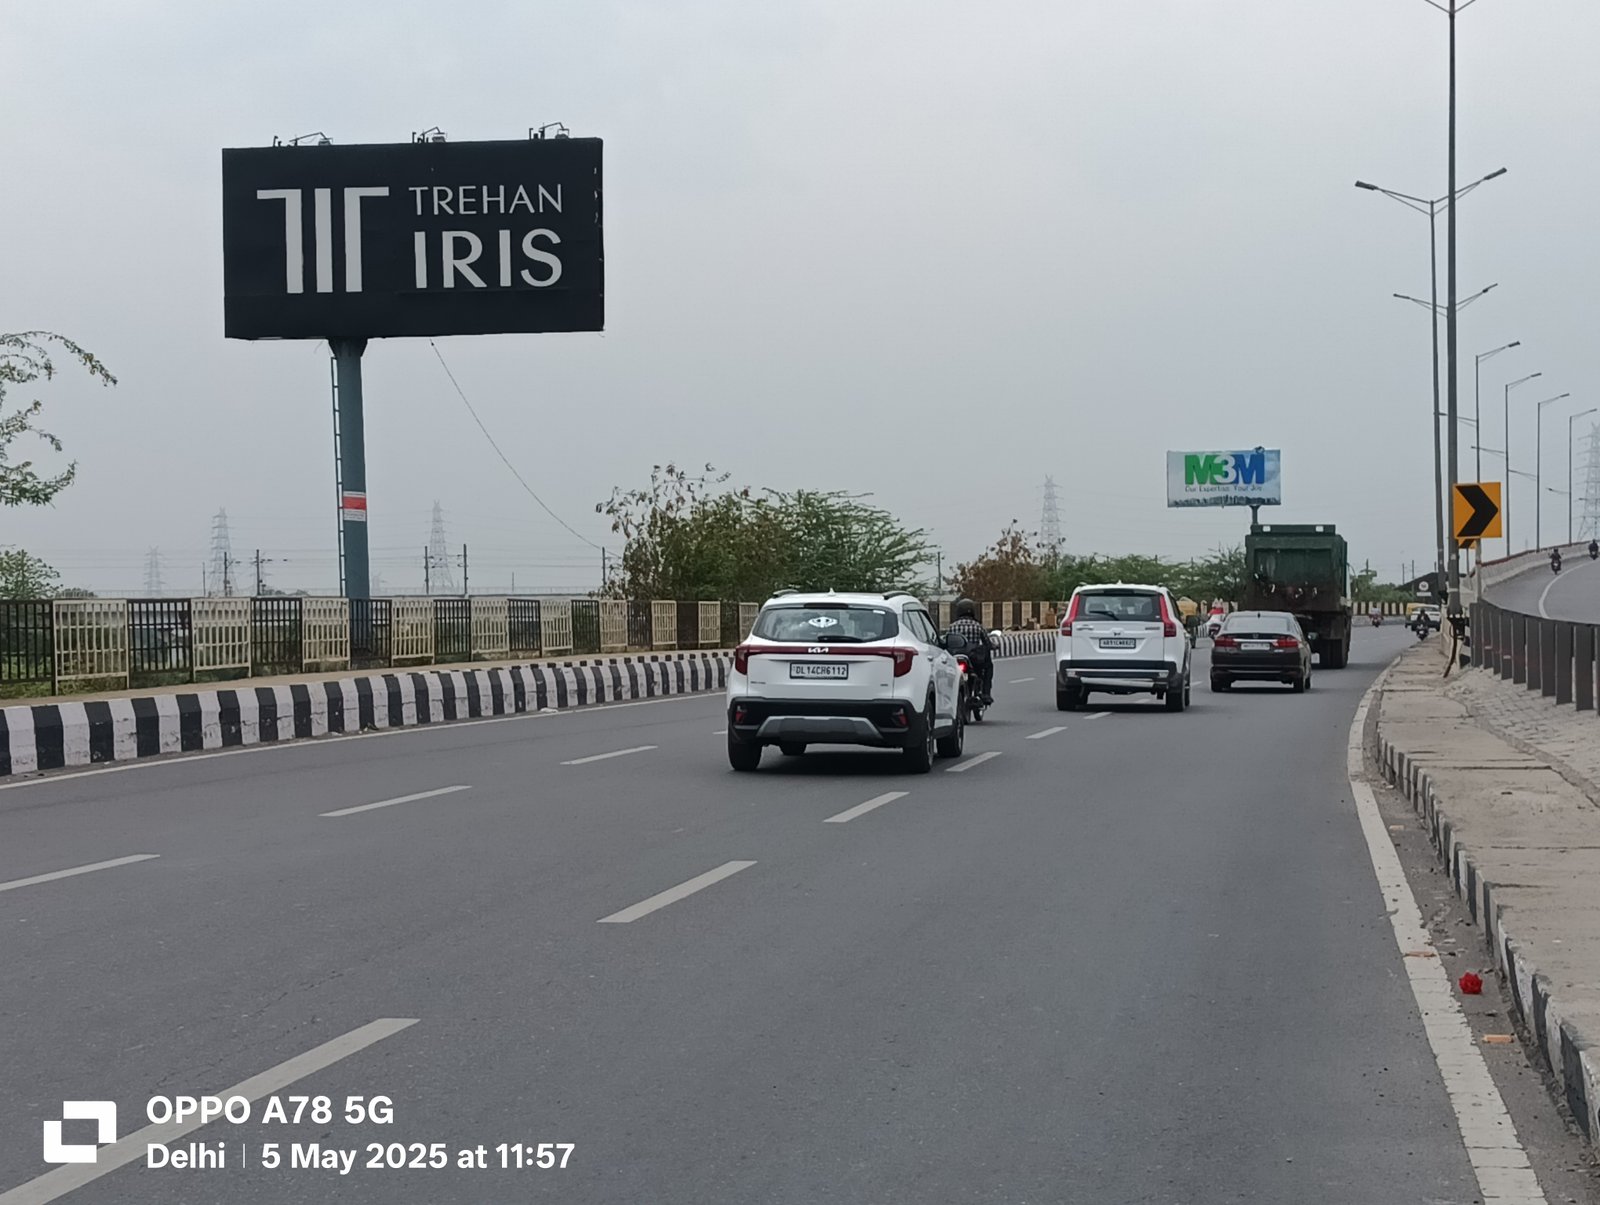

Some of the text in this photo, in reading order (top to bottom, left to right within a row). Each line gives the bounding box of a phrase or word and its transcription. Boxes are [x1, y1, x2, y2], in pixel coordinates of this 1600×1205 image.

[408, 183, 562, 216] TREHAN
[414, 228, 563, 289] IRIS
[1184, 453, 1265, 486] M3M
